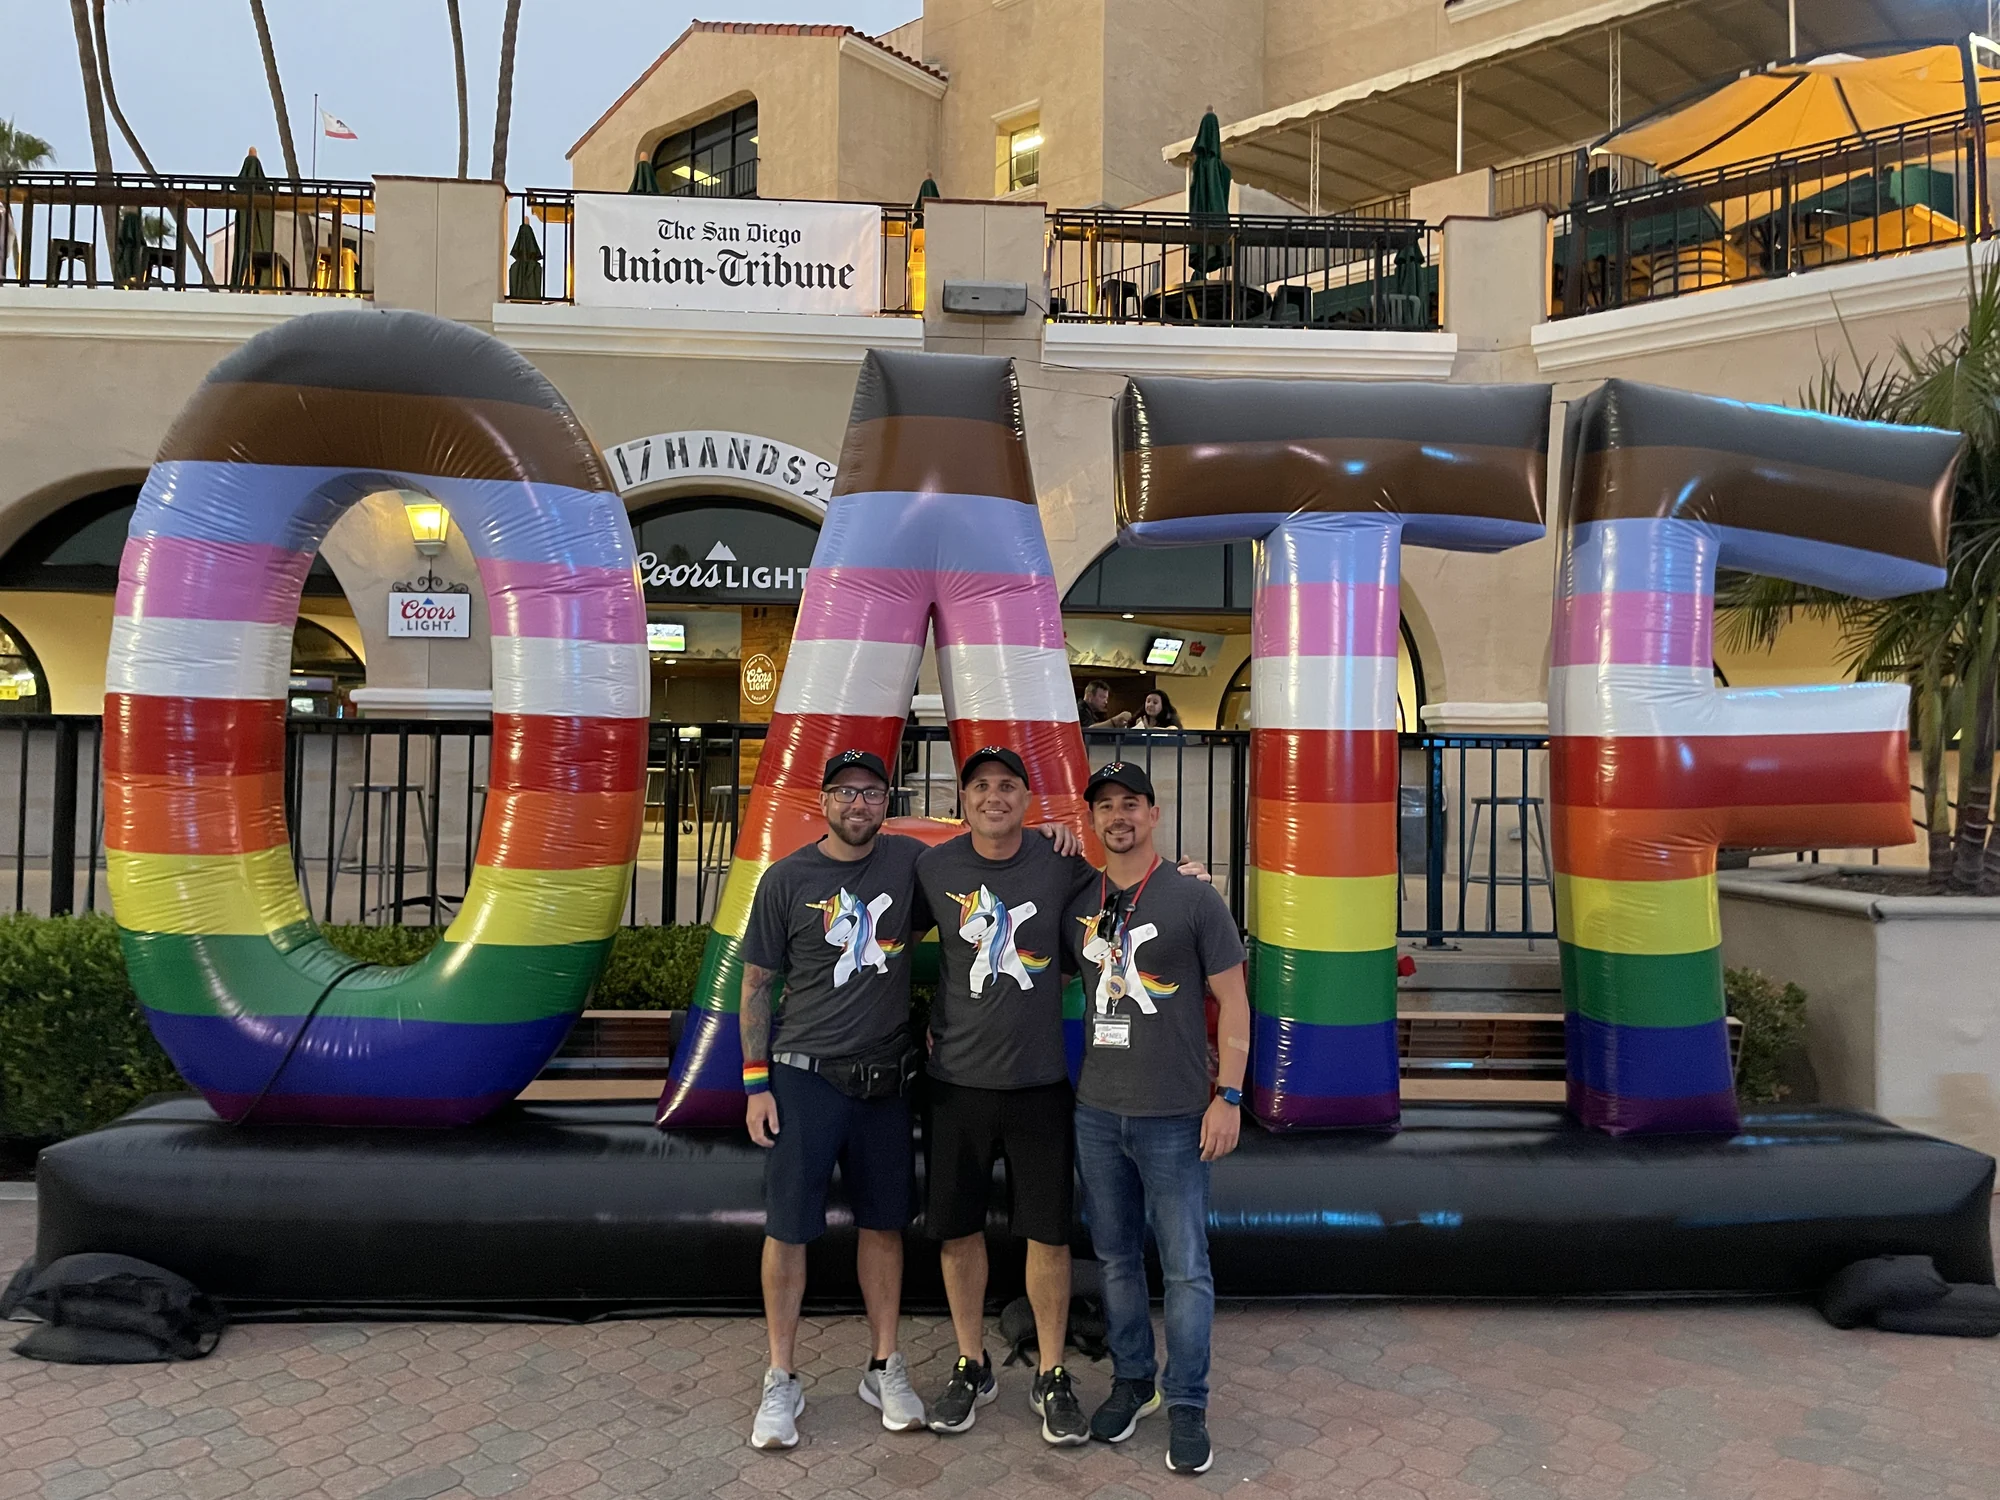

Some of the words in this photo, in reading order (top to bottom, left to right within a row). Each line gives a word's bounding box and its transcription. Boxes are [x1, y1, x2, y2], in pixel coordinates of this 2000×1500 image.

[657, 218, 695, 240] The
[701, 221, 740, 242] San
[746, 222, 801, 248] Diego
[599, 245, 855, 290] Union-Tribune
[614, 439, 651, 486] 17
[665, 436, 806, 485] HANDS
[638, 551, 722, 588] Coors
[726, 566, 809, 589] LIGHT
[401, 598, 456, 620] Coors
[407, 620, 451, 631] LIGHT
[747, 669, 772, 683] Coors
[749, 682, 769, 691] LIGHT
